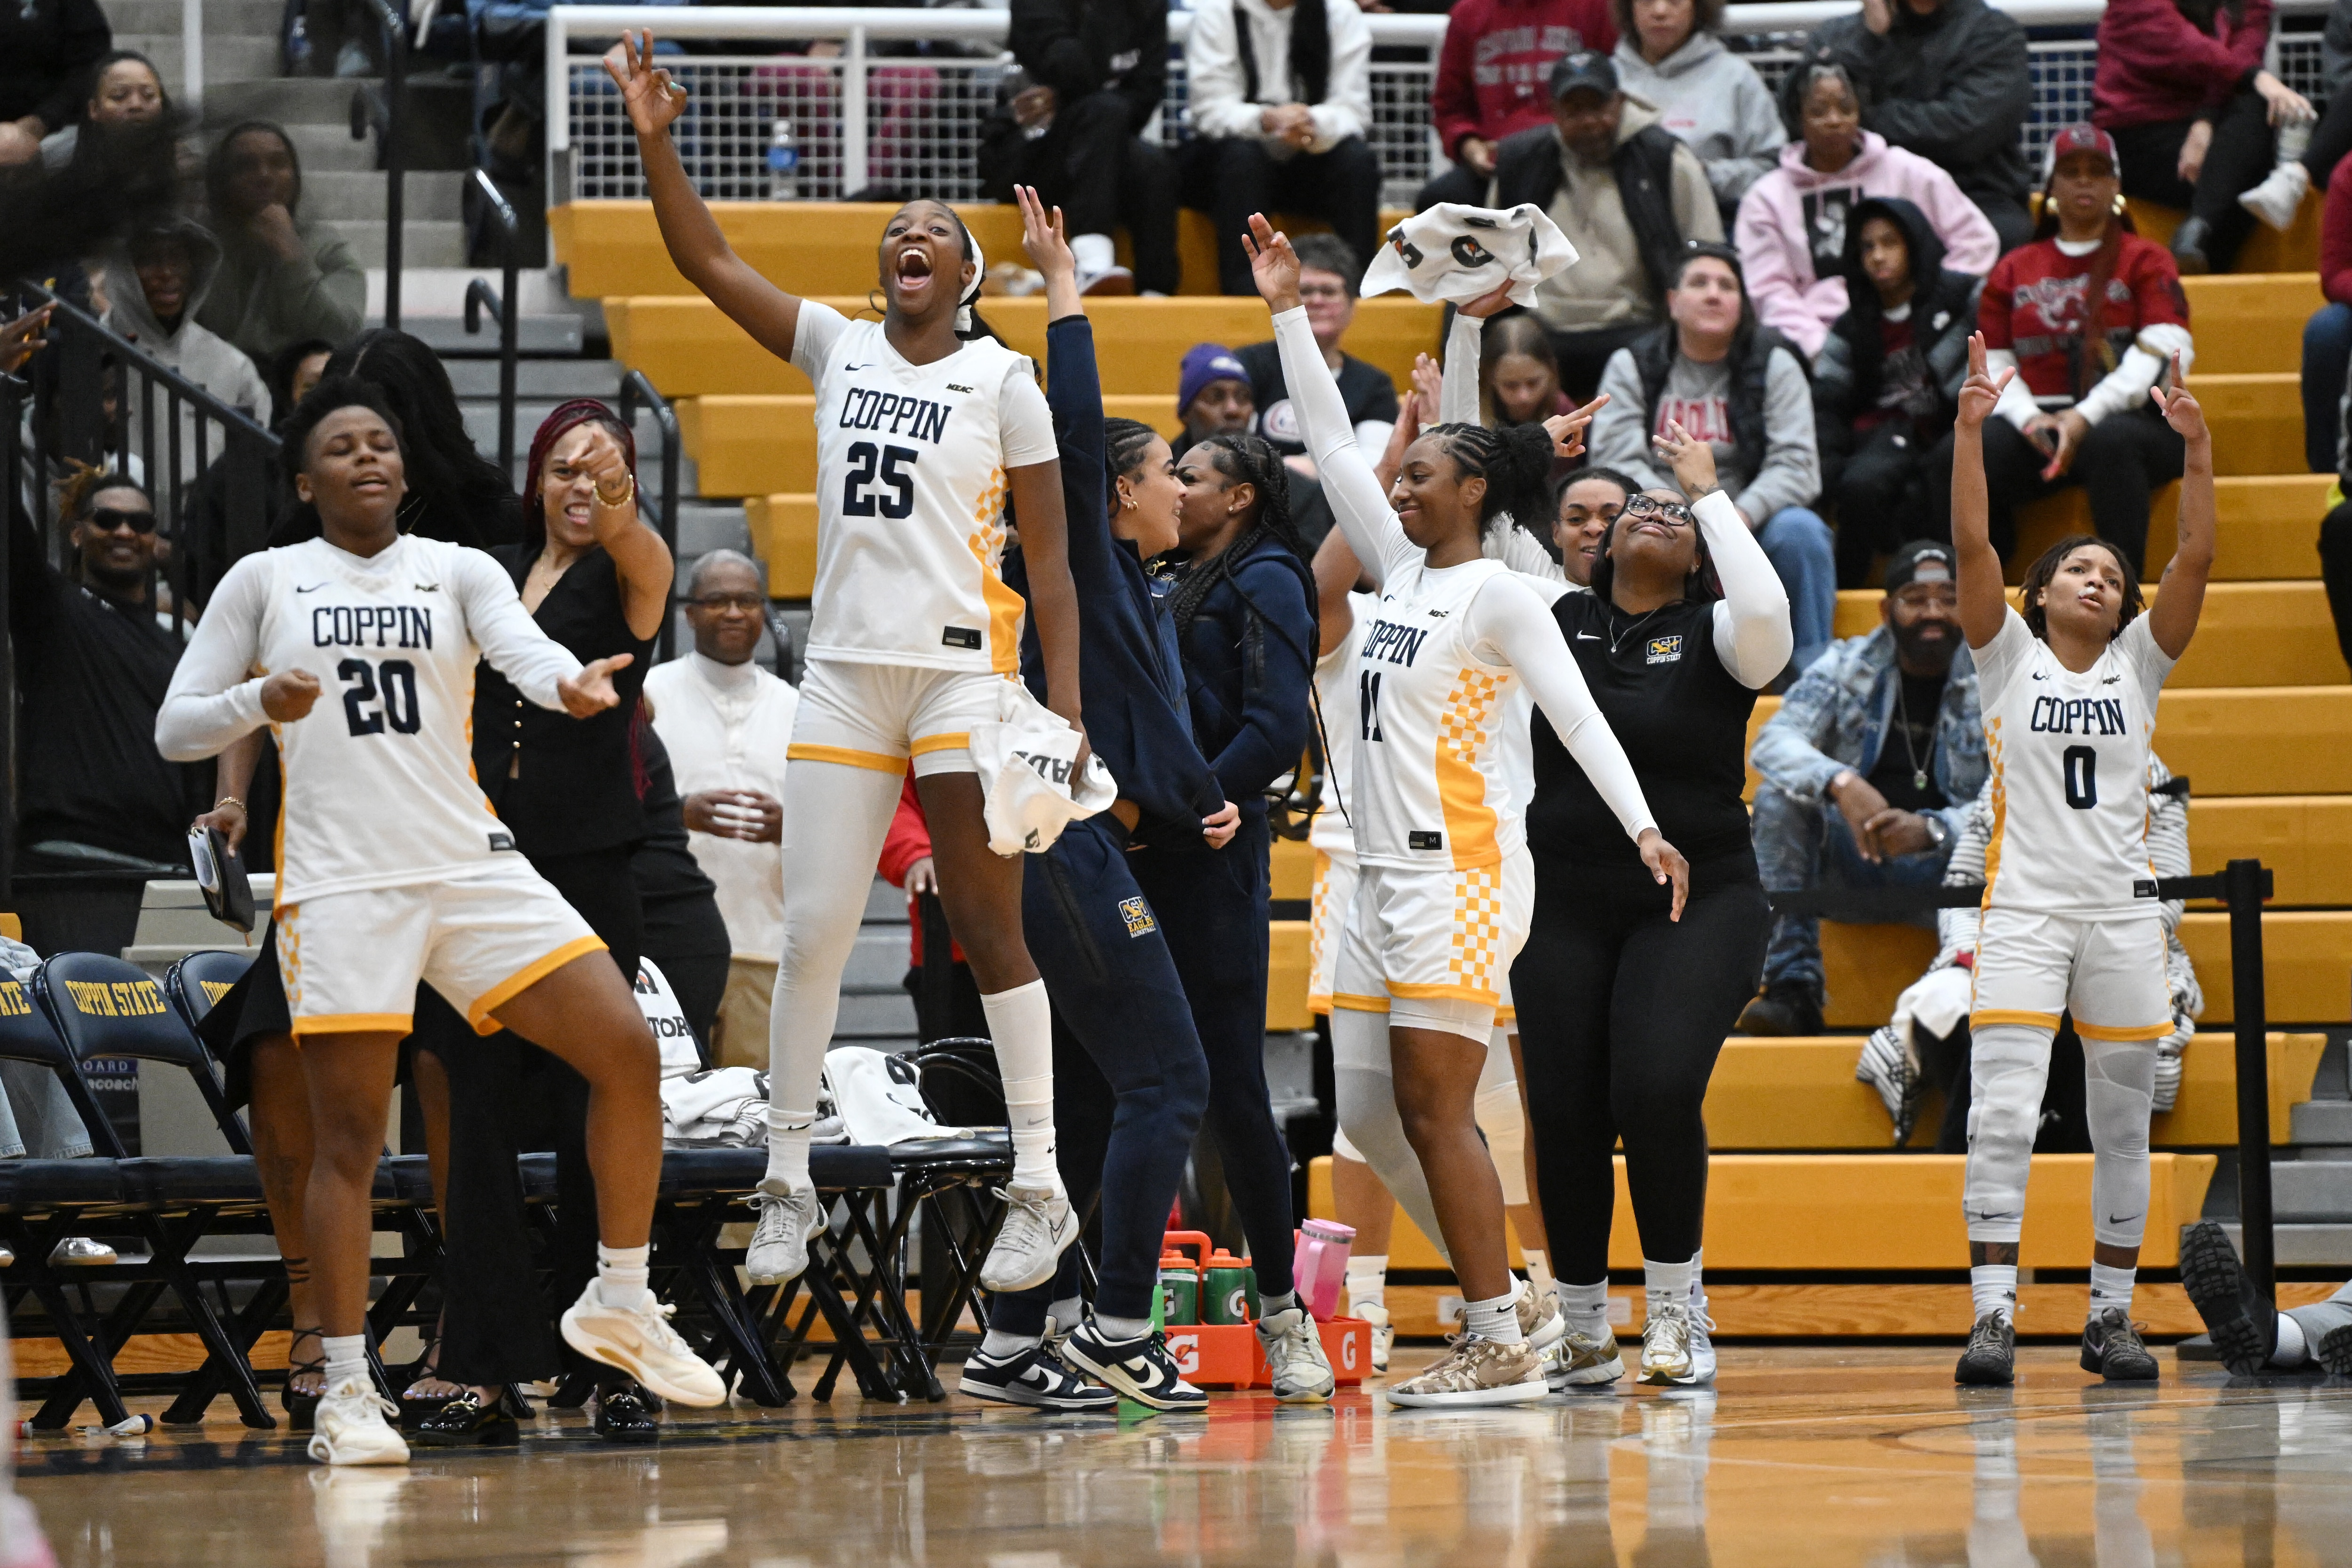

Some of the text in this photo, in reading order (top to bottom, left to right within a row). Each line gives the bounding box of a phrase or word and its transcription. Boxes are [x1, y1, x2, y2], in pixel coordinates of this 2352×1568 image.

[946, 383, 974, 394] MEAC
[840, 388, 952, 444] COPPIN
[843, 441, 919, 519] 25
[313, 605, 432, 649] COPPIN
[1361, 618, 1428, 667] OPPIN
[1647, 635, 1682, 657] CSU
[1647, 656, 1666, 665] COPPIN
[338, 658, 421, 736] 20
[1361, 669, 1383, 742] 11
[2031, 696, 2126, 735] COPPIN
[2063, 745, 2097, 809] 0
[1118, 896, 1150, 923] CSU
[1127, 917, 1154, 933] EAGLES
[1129, 925, 1156, 938] BASKETBALL
[65, 980, 167, 1016] COPPIN STATE
[1164, 1334, 1199, 1374] G
[1342, 1331, 1356, 1370] G
